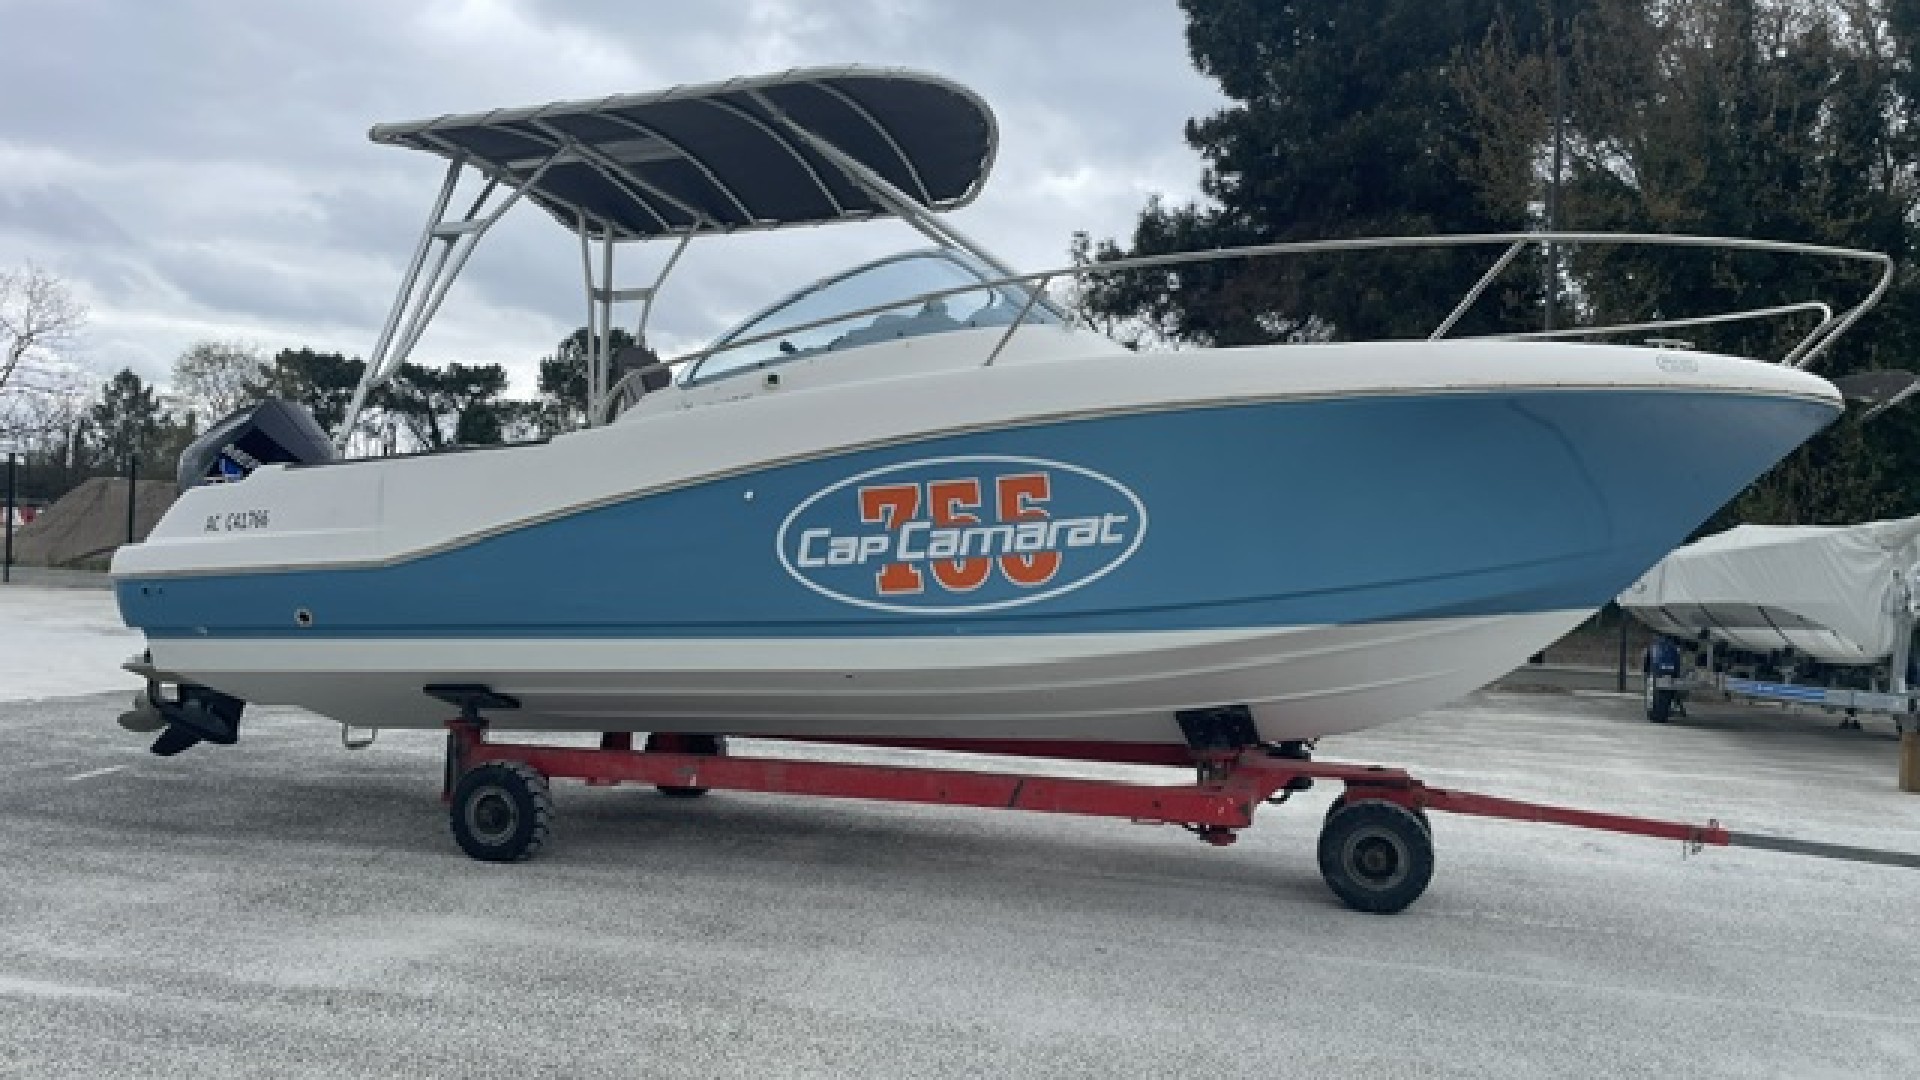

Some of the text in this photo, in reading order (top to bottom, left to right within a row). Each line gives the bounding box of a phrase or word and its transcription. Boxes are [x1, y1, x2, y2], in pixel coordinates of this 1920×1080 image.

[798, 512, 1129, 568] Cap Camarat
[857, 471, 1063, 597] 755
